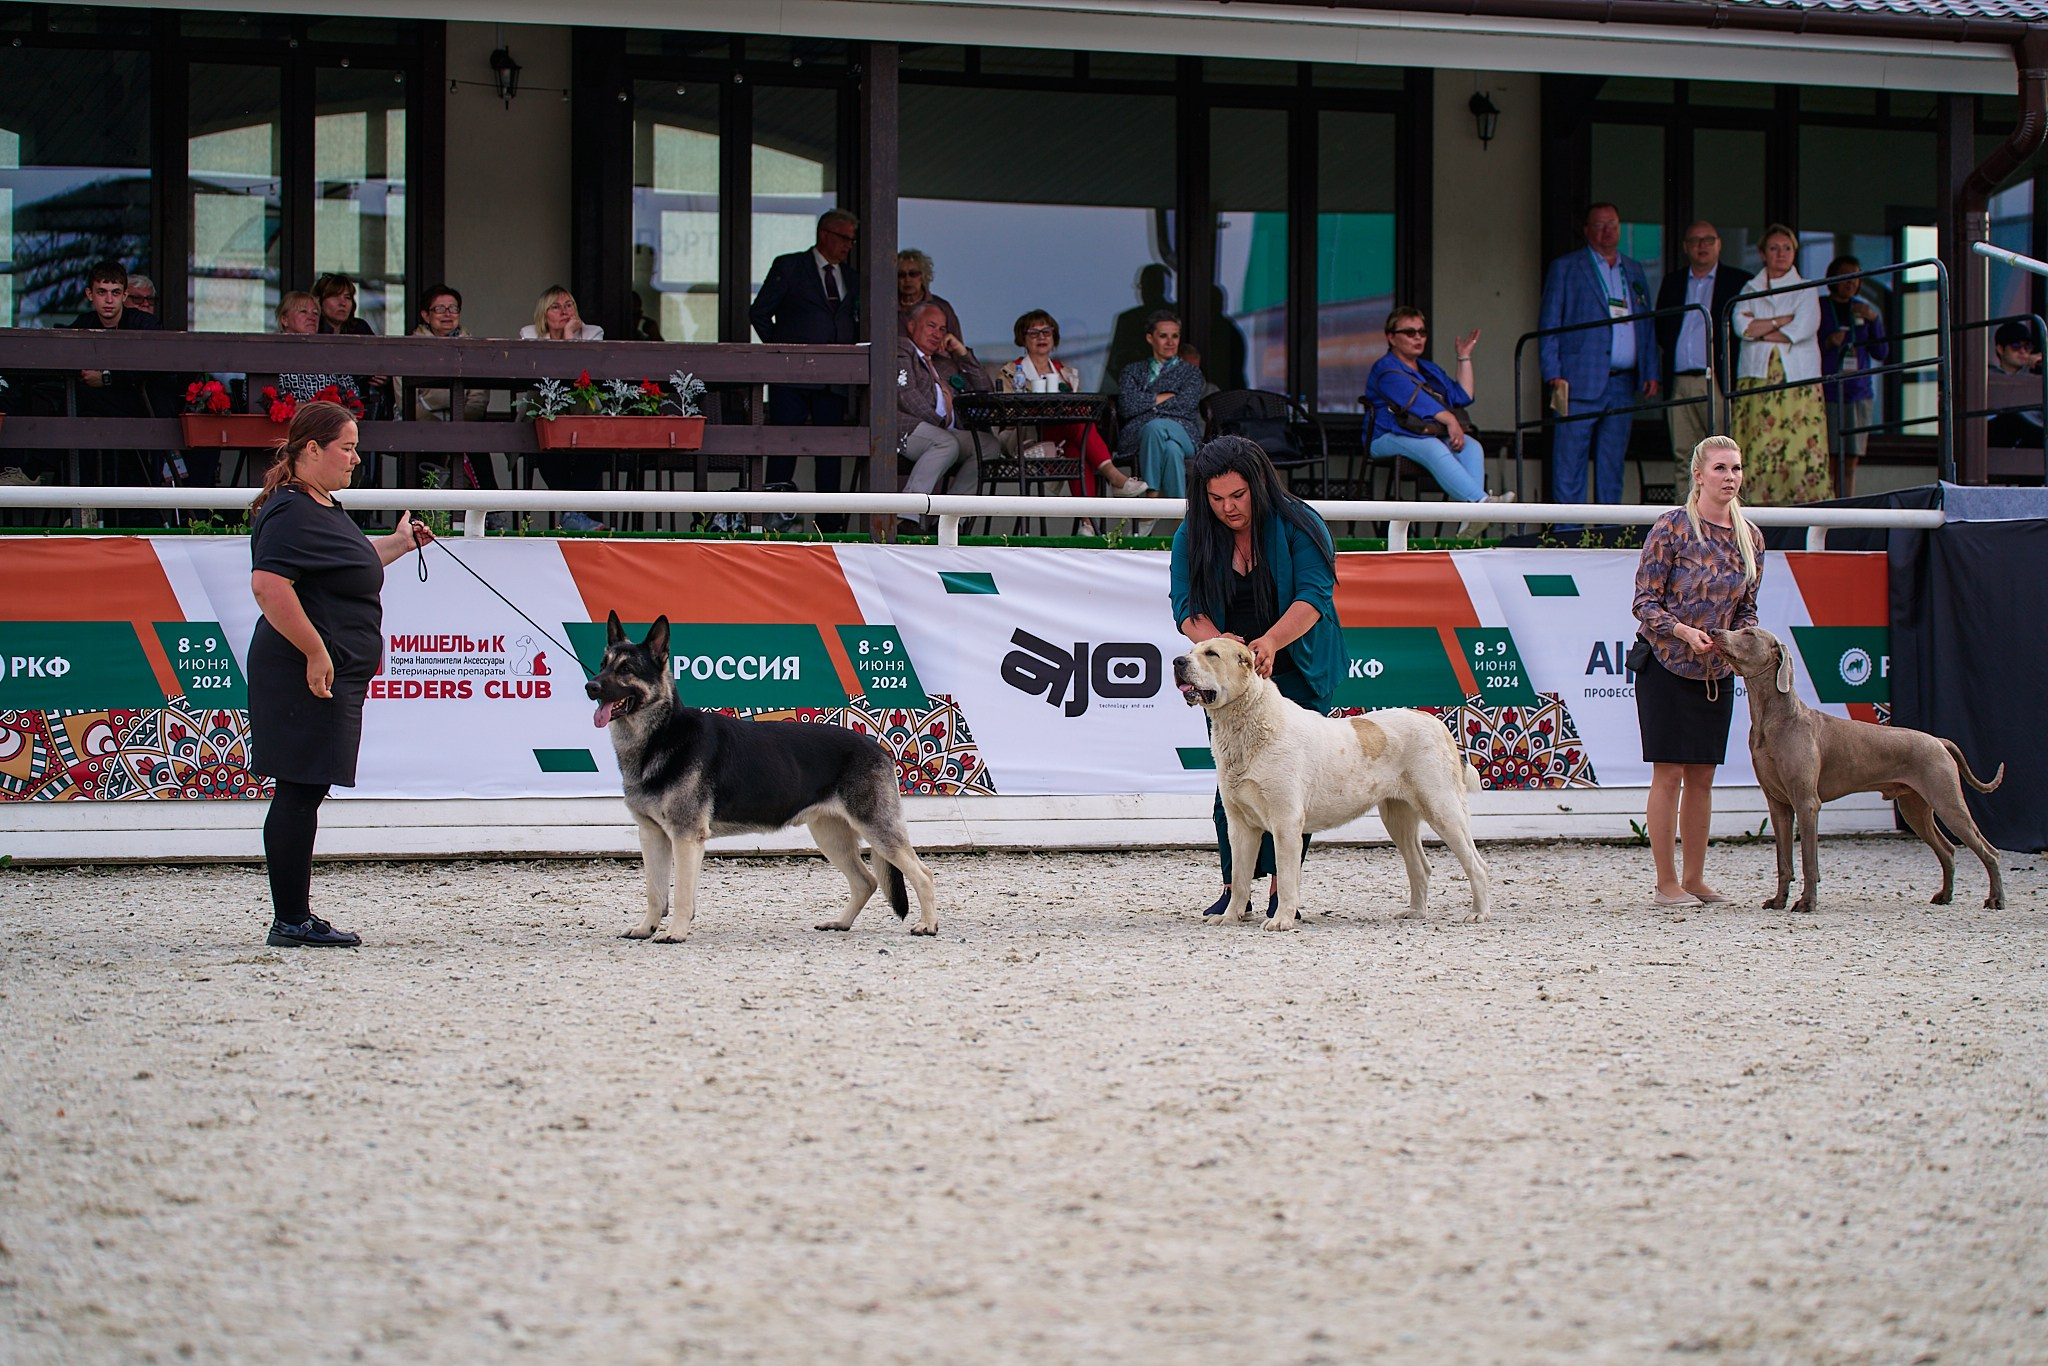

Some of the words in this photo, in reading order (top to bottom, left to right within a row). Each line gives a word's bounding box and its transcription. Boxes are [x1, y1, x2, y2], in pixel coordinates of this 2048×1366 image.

[390, 635, 475, 653] МИШЕЛЬ
[478, 639, 489, 653] и
[492, 635, 506, 653] К
[178, 658, 229, 670] ИЮНЯ
[390, 655, 414, 666] Корма
[415, 655, 462, 665] Наполнители
[463, 655, 505, 666] Аксессуары
[859, 660, 905, 671] ИЮНЯ
[1475, 660, 1517, 671] ИЮНЯ
[11, 656, 71, 678] РКФ
[390, 667, 456, 677] Ветеринарные
[457, 668, 506, 677] препараты
[673, 655, 801, 681] РОССИЯ
[1348, 658, 1384, 679] КФ
[192, 676, 232, 689] 2024
[871, 677, 908, 689] 2024
[1486, 676, 1519, 688] 2024
[365, 680, 473, 700] EEDERS
[484, 680, 552, 700] CLUB
